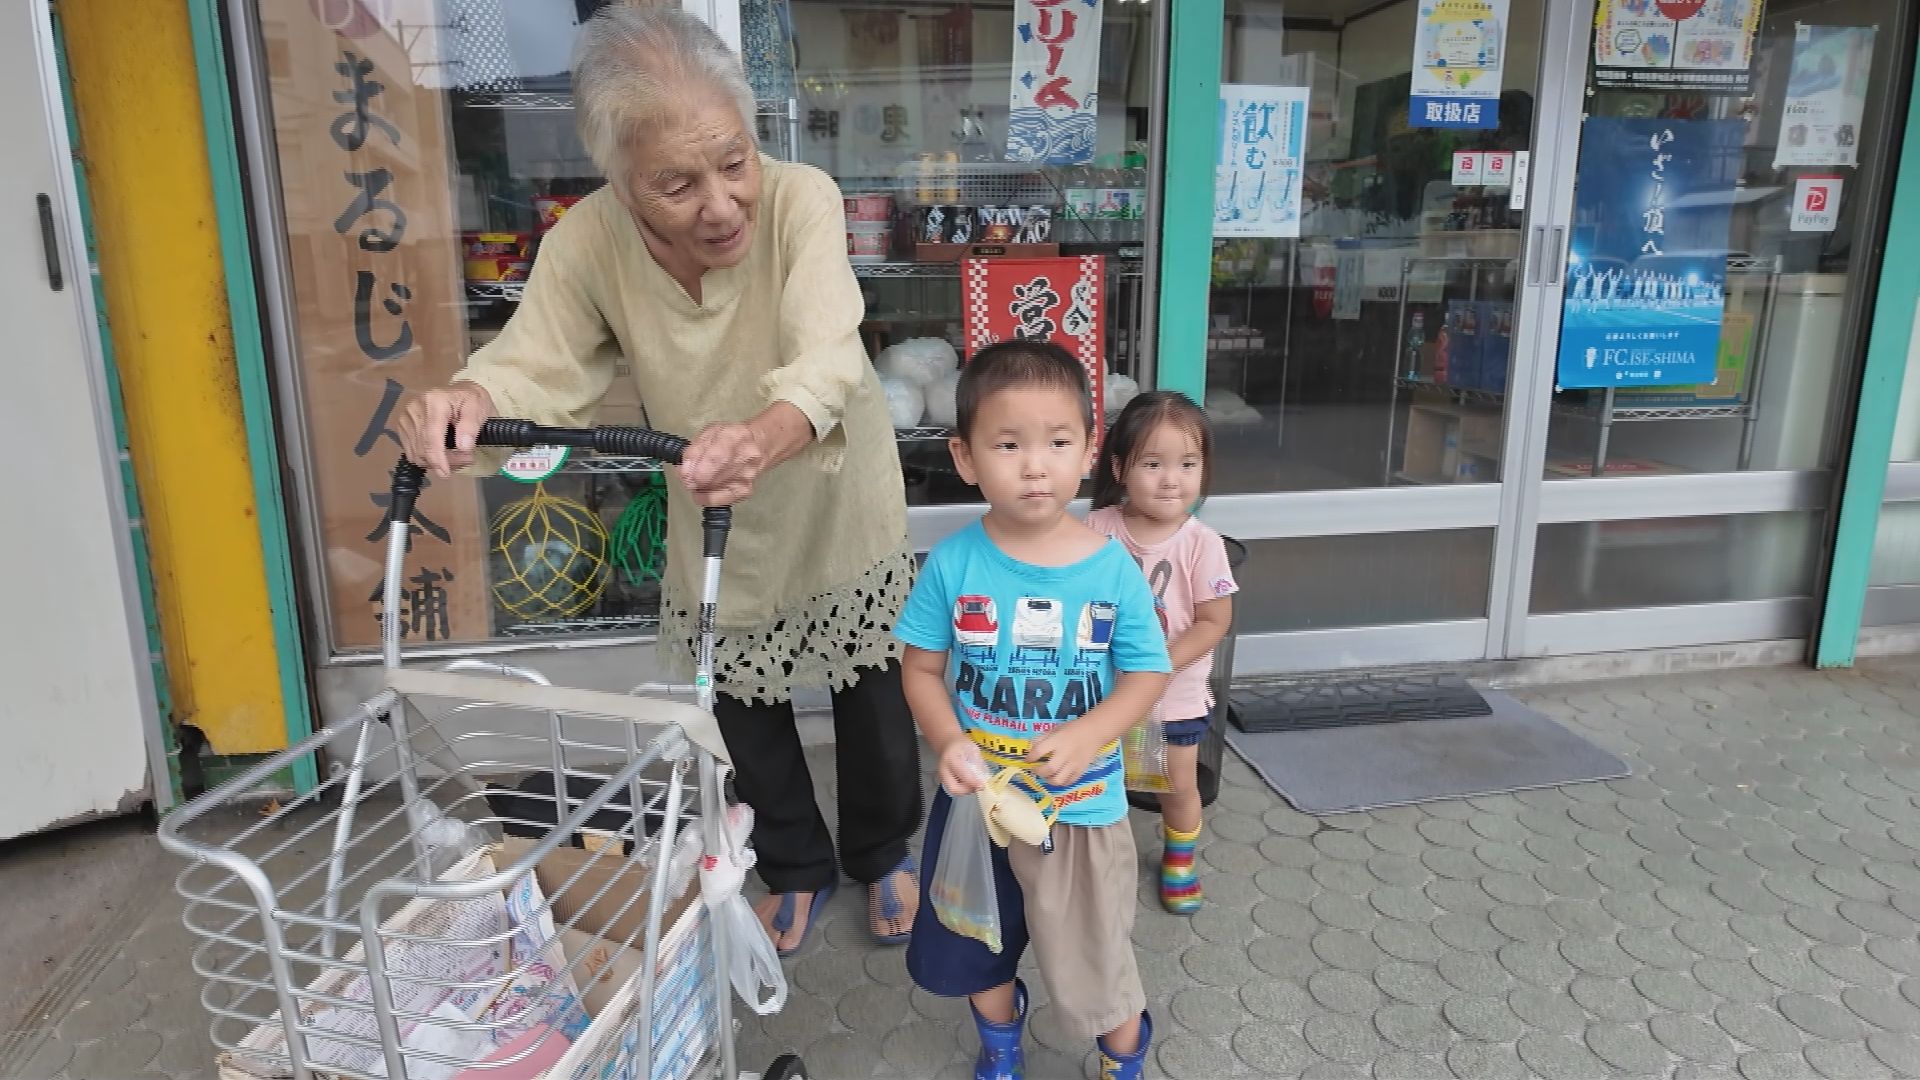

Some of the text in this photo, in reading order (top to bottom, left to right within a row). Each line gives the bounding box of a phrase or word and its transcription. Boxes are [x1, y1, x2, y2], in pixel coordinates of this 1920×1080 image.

[1032, 0, 1081, 110] リーム
[1425, 101, 1482, 123] 取扱店
[1242, 102, 1276, 169] 飲む
[1797, 213, 1830, 225] PayPay
